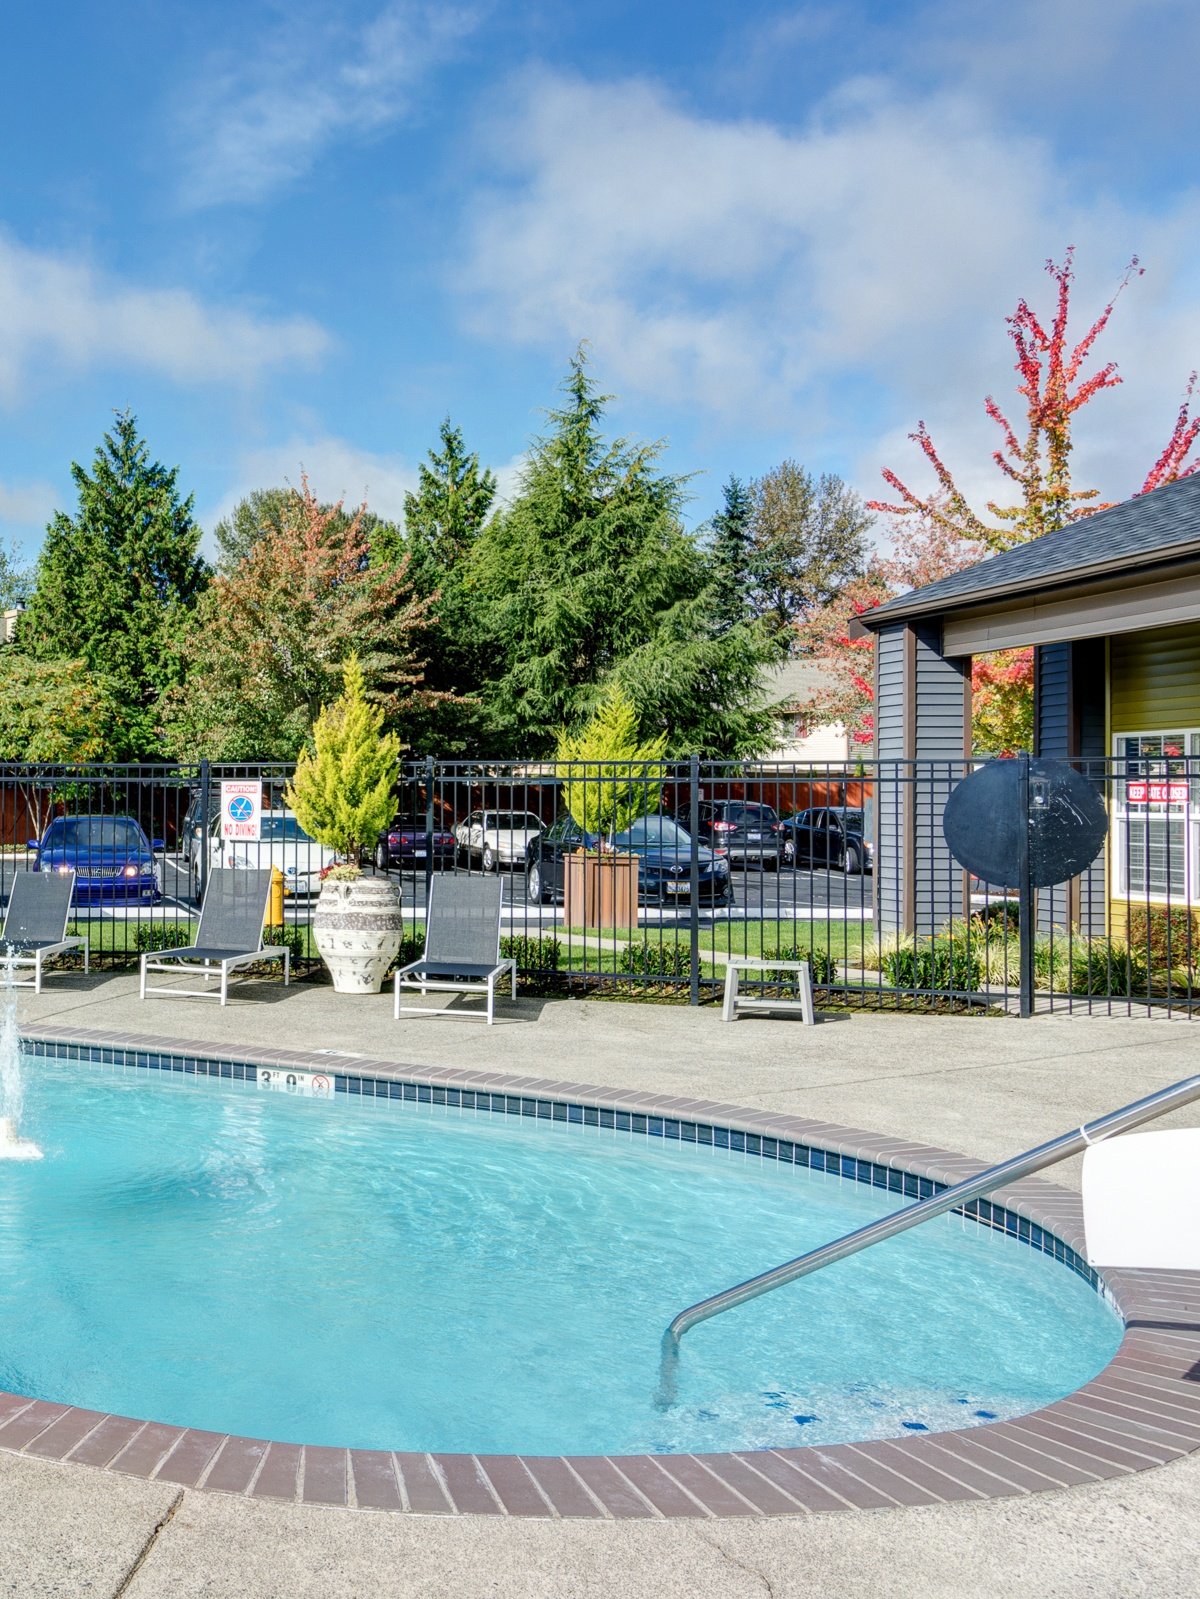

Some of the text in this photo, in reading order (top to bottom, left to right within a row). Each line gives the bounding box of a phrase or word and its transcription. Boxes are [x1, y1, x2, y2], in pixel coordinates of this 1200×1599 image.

[1129, 786, 1145, 799] KEEP
[1162, 786, 1188, 799] COSED
[224, 824, 257, 836] NO DIVING!
[261, 1071, 271, 1082] 3
